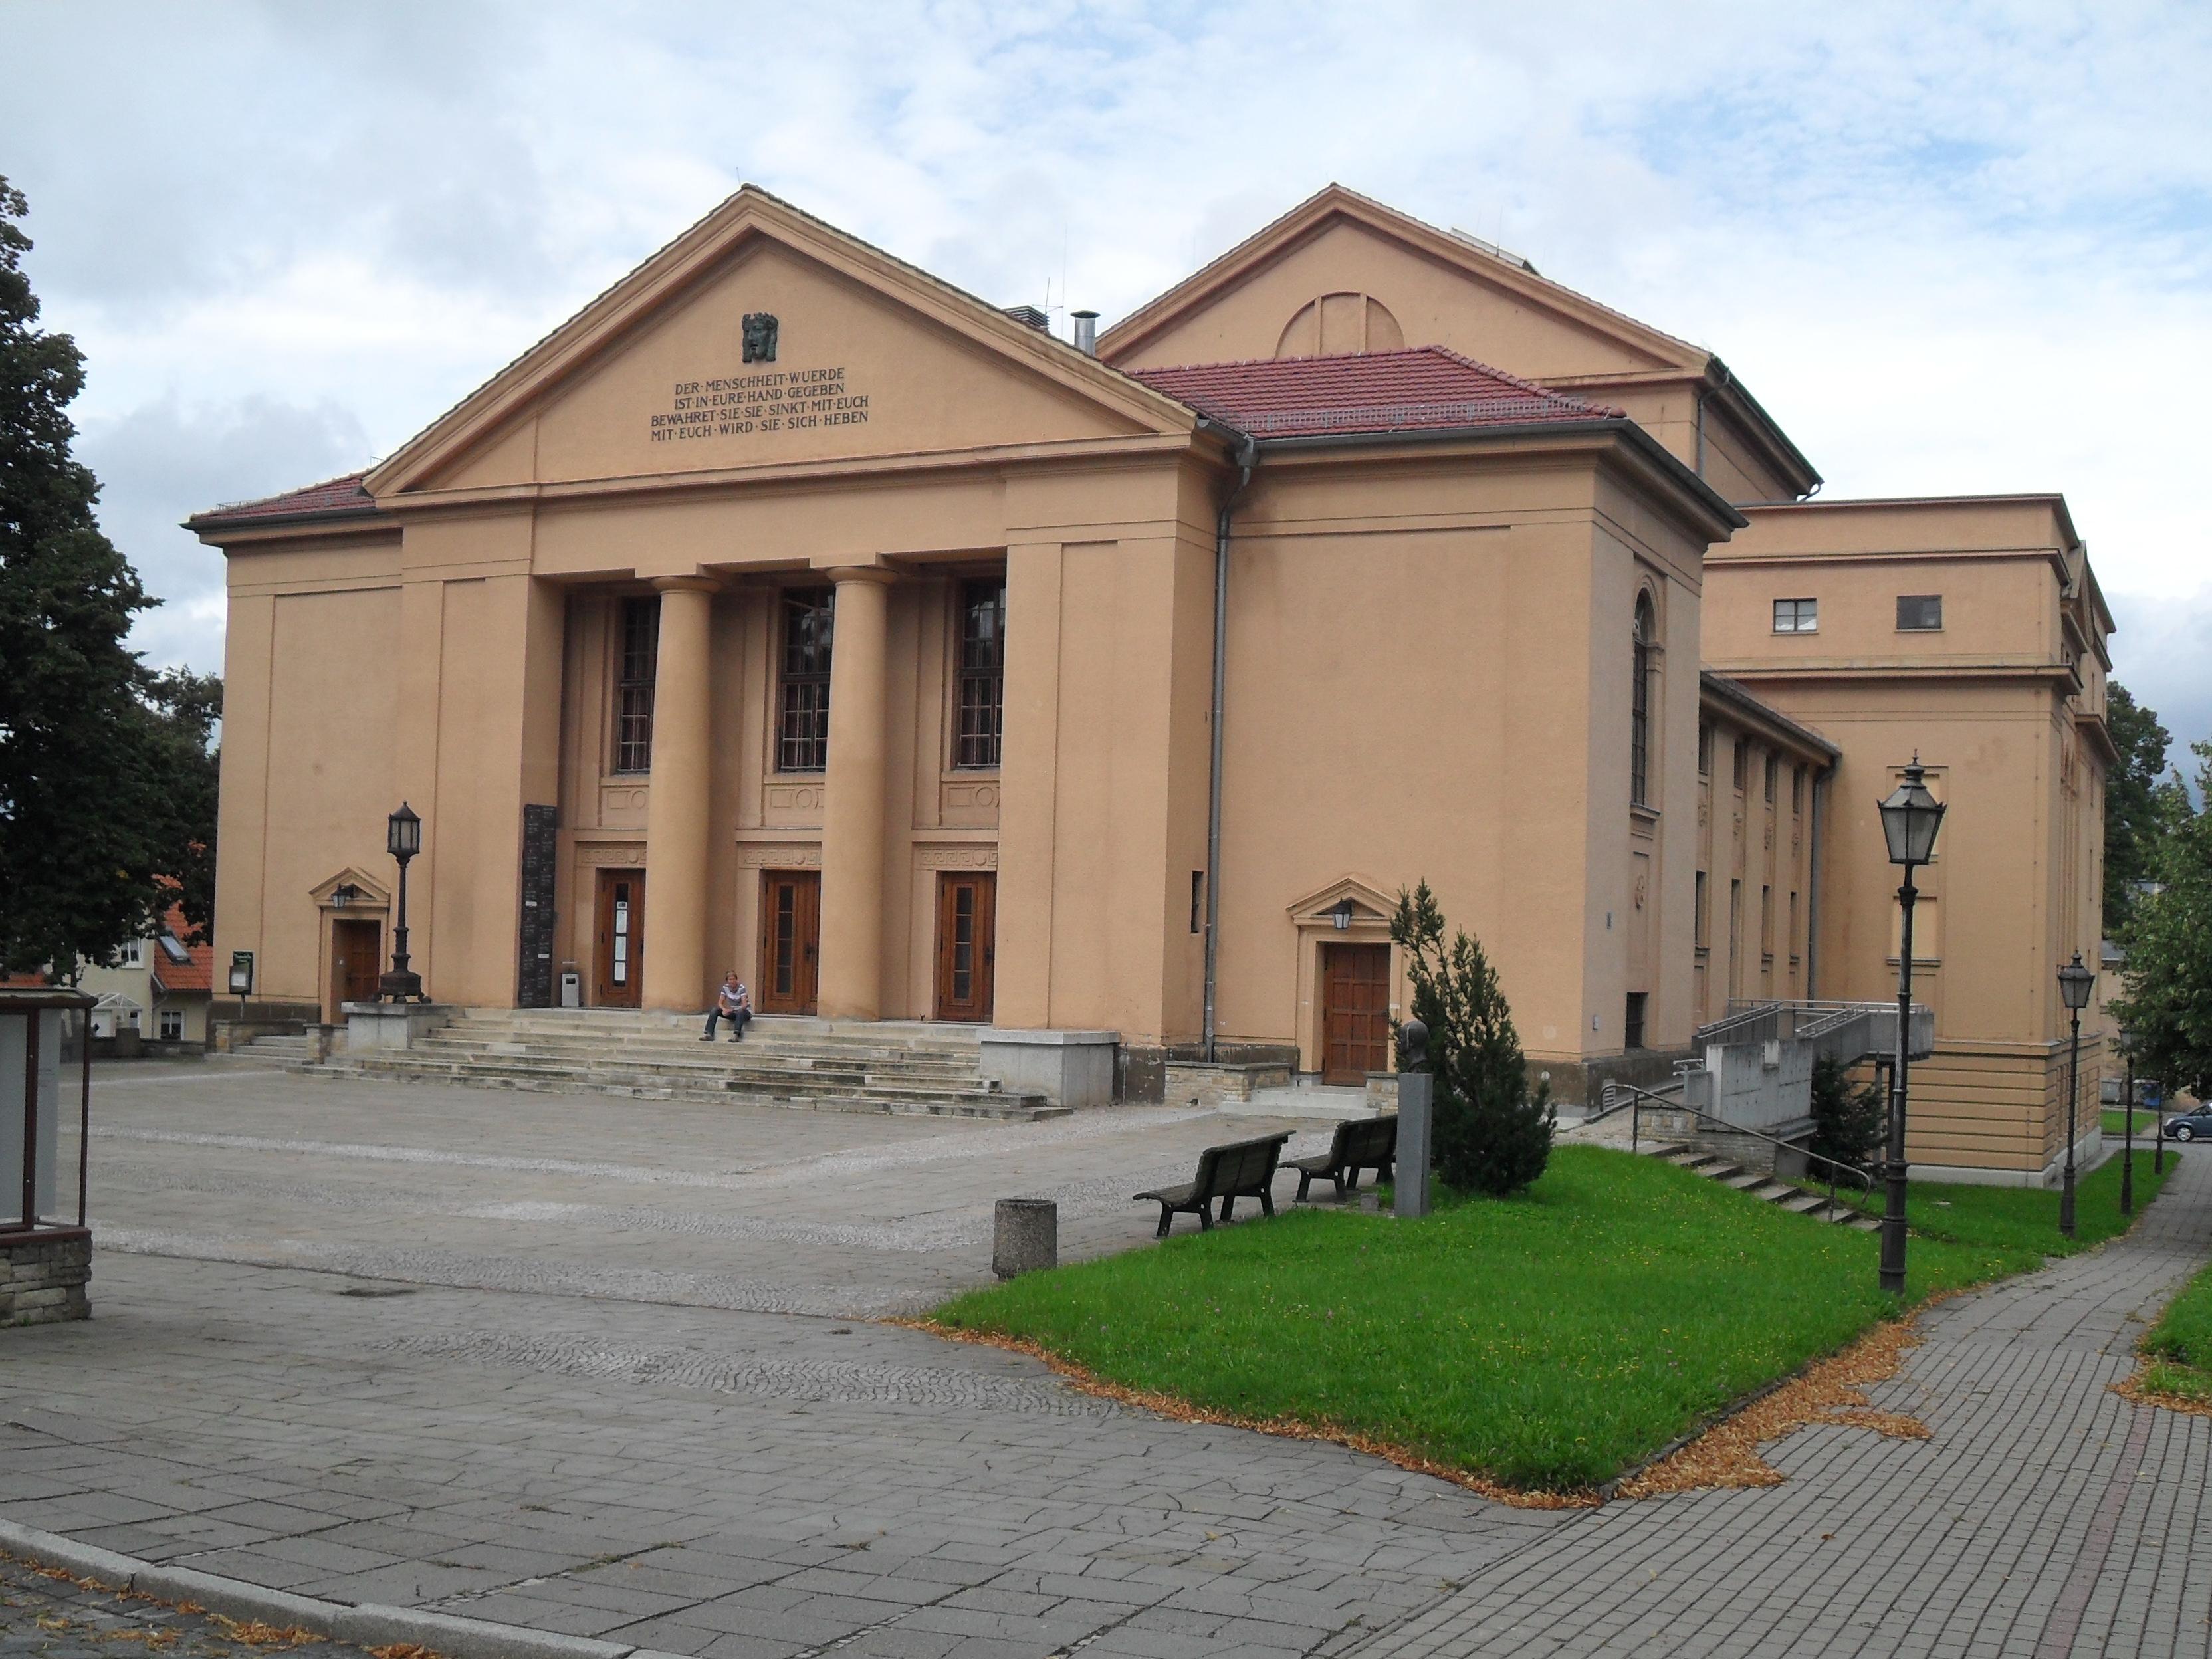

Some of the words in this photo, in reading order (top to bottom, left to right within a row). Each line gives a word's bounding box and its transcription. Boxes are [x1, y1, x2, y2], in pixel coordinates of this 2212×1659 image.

[675, 382, 699, 395] DER
[705, 373, 785, 392] MENSCHHEIT
[789, 368, 845, 384] WUERDE
[651, 410, 716, 426] BEWAHRET
[720, 407, 740, 420] SIE
[744, 405, 763, 417] SIE
[768, 401, 806, 415] SINKT
[811, 399, 833, 411] MIT
[837, 395, 869, 409] EUCH
[675, 397, 692, 410] IST
[695, 395, 708, 407] IN
[712, 392, 744, 405] EURE
[748, 389, 782, 402] HAND
[788, 383, 845, 398] GEGEBEN
[651, 429, 673, 441] MIT
[679, 425, 711, 439] EUCH
[719, 421, 753, 435] WIRD
[760, 419, 780, 431] SIE
[788, 415, 817, 429] SICH
[824, 411, 868, 425] HEBEN
